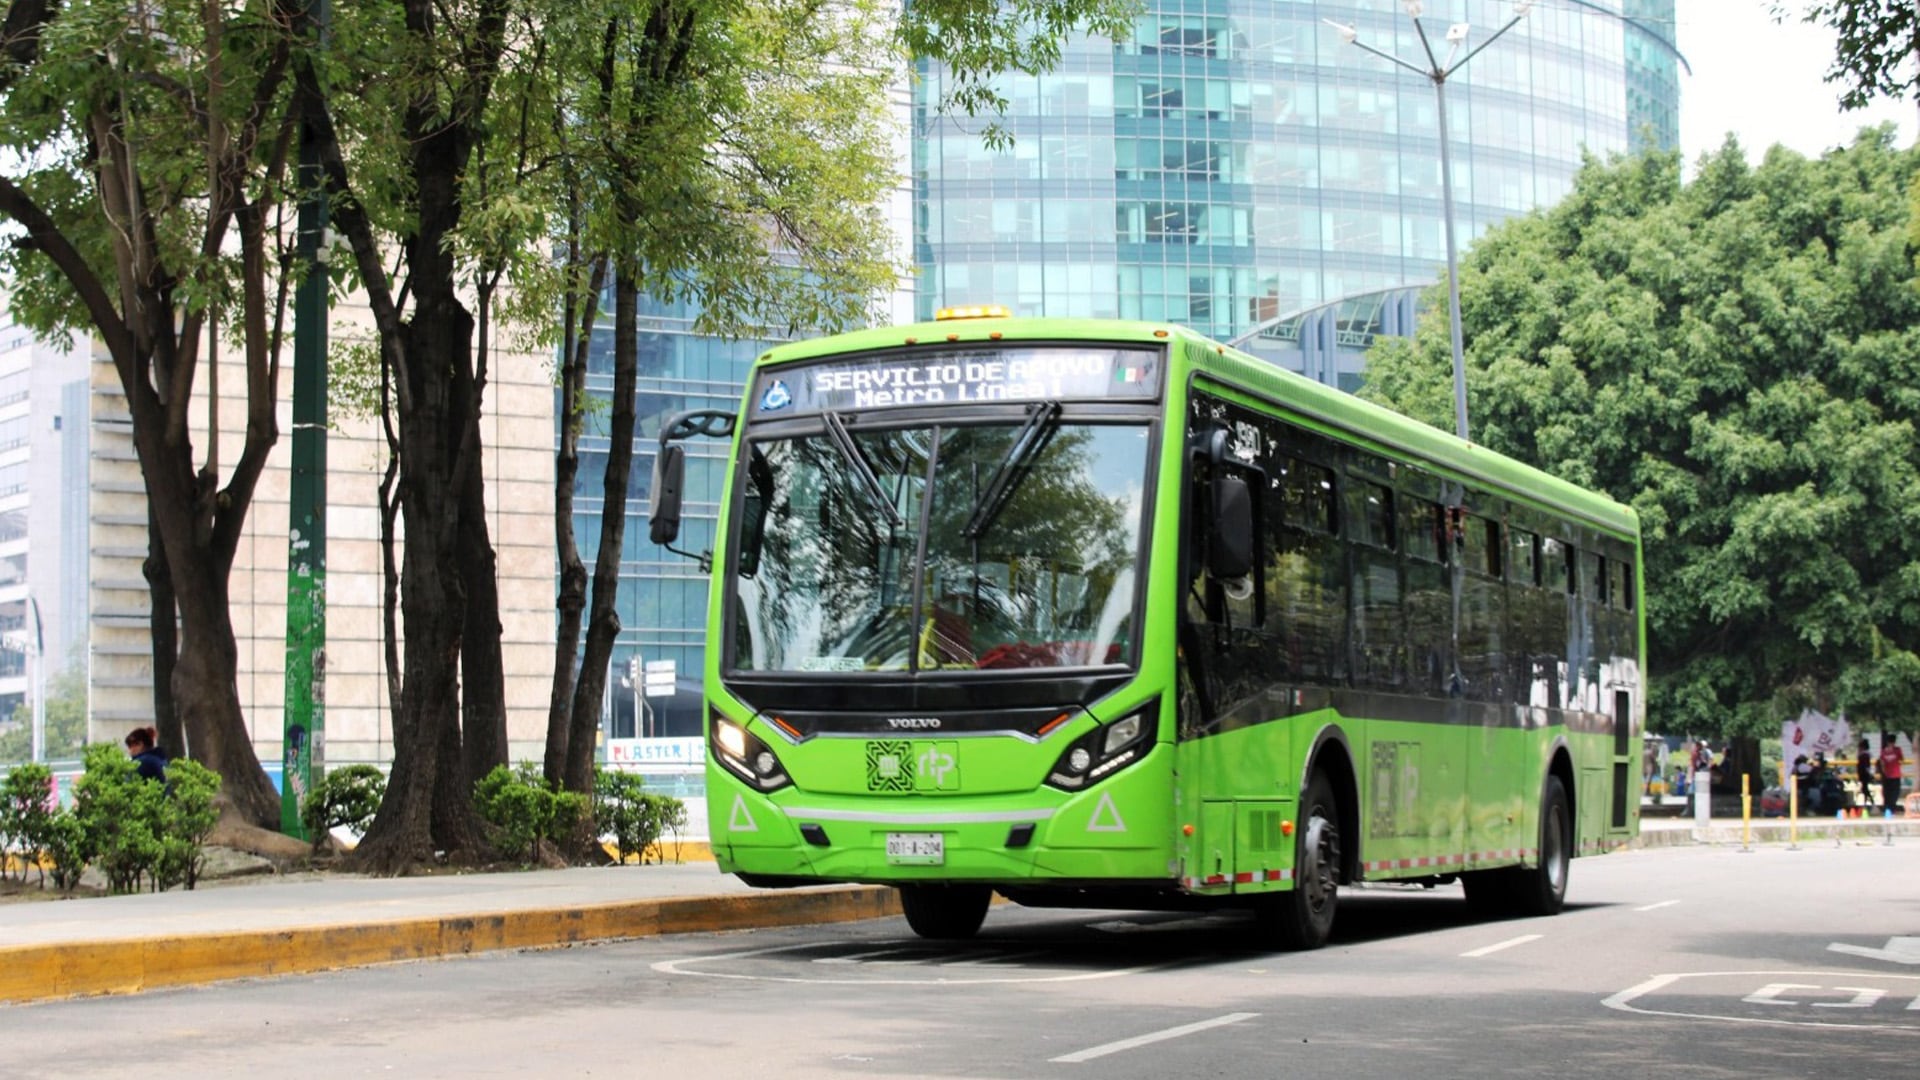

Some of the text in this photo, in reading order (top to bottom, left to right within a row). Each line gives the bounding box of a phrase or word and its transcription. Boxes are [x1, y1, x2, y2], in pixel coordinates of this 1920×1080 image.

[815, 354, 1105, 392] SERVICIO DE APOYO
[854, 386, 945, 408] Metro
[888, 718, 941, 728] VOLVO
